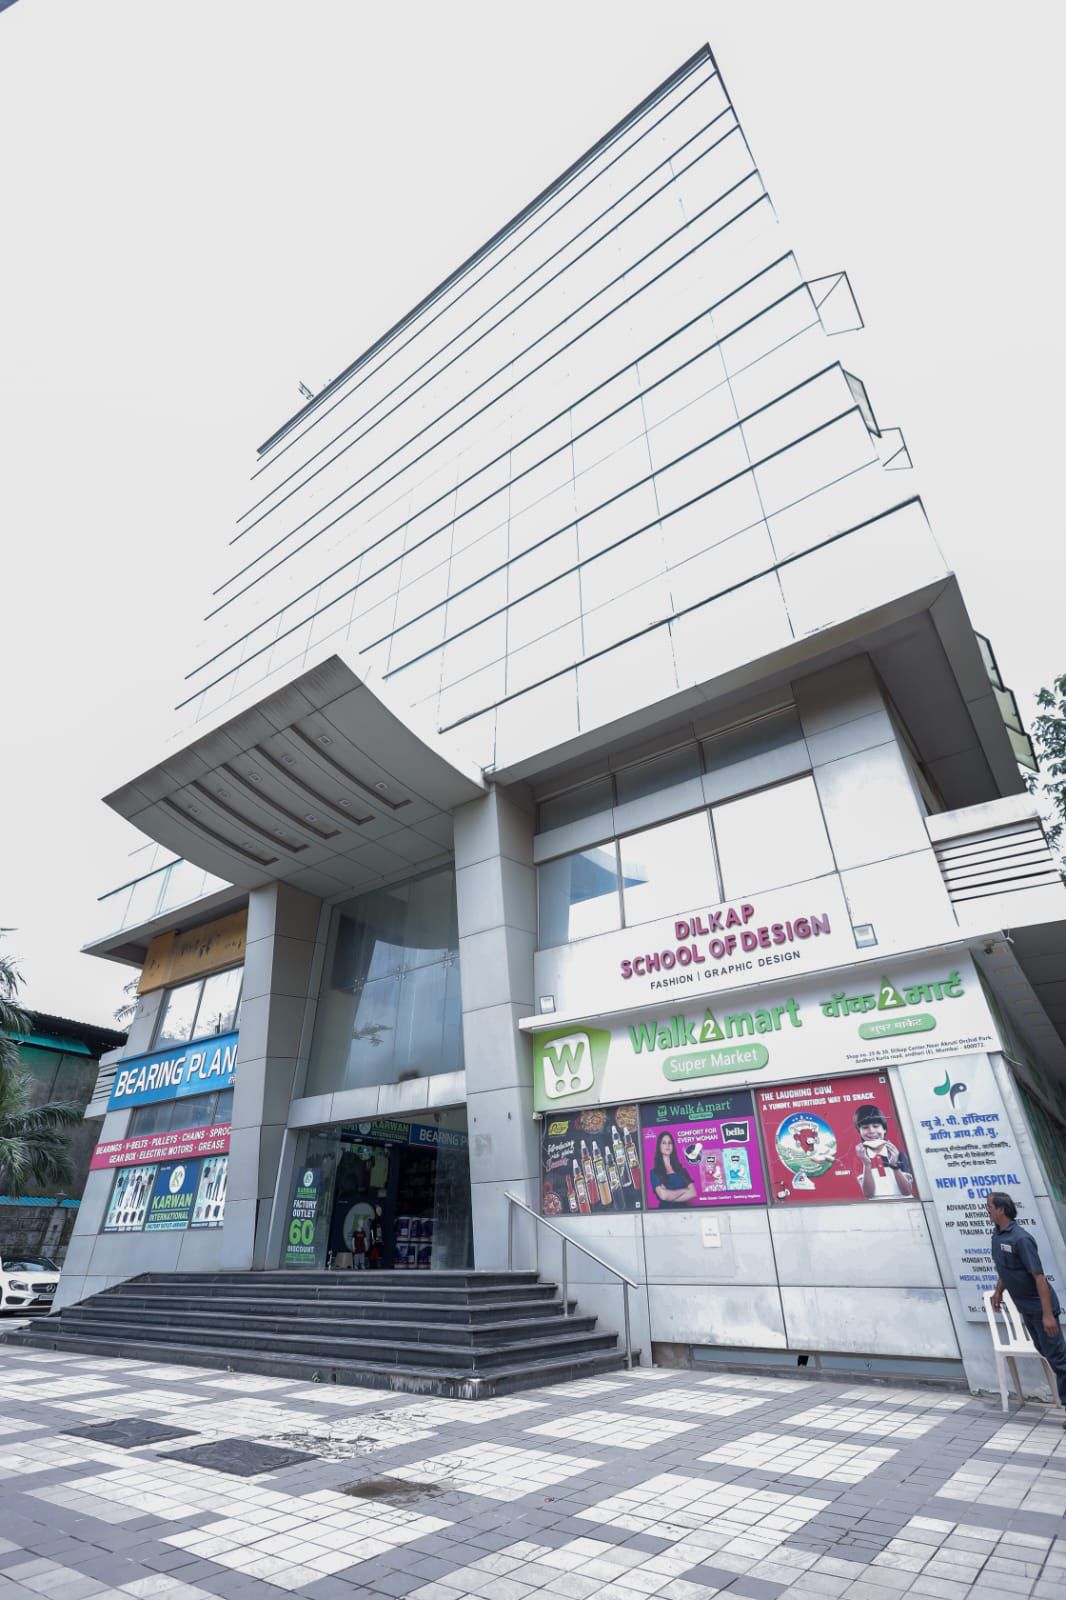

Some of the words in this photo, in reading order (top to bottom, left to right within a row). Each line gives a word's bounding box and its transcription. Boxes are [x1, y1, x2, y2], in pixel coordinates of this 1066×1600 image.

[674, 904, 755, 941] DILKAP
[620, 944, 706, 980] SCHOOL
[708, 934, 738, 960] OF
[740, 913, 832, 952] DESIGN
[650, 974, 694, 990] FASHION
[704, 961, 753, 979] GRAPHIC
[758, 950, 801, 967] DESIGN
[114, 1057, 187, 1098] BEARING
[187, 1044, 238, 1083] PLAN
[669, 1057, 706, 1075] Super
[711, 1052, 759, 1068] Market
[760, 1092, 775, 1102] THE
[775, 1088, 812, 1100] LAUGHING
[792, 1097, 827, 1109] NUTRITIOUS
[827, 1096, 841, 1104] WAY
[842, 1094, 851, 1102] TO
[419, 1128, 459, 1147] BEARING
[677, 1129, 705, 1137] COMFORT
[696, 1134, 719, 1142] WOMAN
[725, 1124, 745, 1137] bella
[95, 1143, 122, 1155] BEARINGS
[151, 1135, 178, 1146] PULLEYS
[181, 1130, 205, 1142] CHAINS
[139, 1148, 167, 1160] ELECTRIC
[167, 1144, 194, 1156] MOTORS
[197, 1139, 225, 1152] GREASE
[935, 1178, 957, 1189] NEW
[958, 1177, 969, 1189] JP
[971, 1173, 1021, 1186] HOSPITAL
[152, 1193, 193, 1209] KARWAN
[293, 1199, 317, 1209] FACTORY
[946, 1203, 977, 1211] ADVANCED
[148, 1211, 189, 1221] INTERNATIONAL
[292, 1208, 316, 1218] OUTLET
[288, 1218, 315, 1246] 60
[287, 1245, 316, 1253] DISCOUNT
[964, 1247, 993, 1255] PATHOLOG
